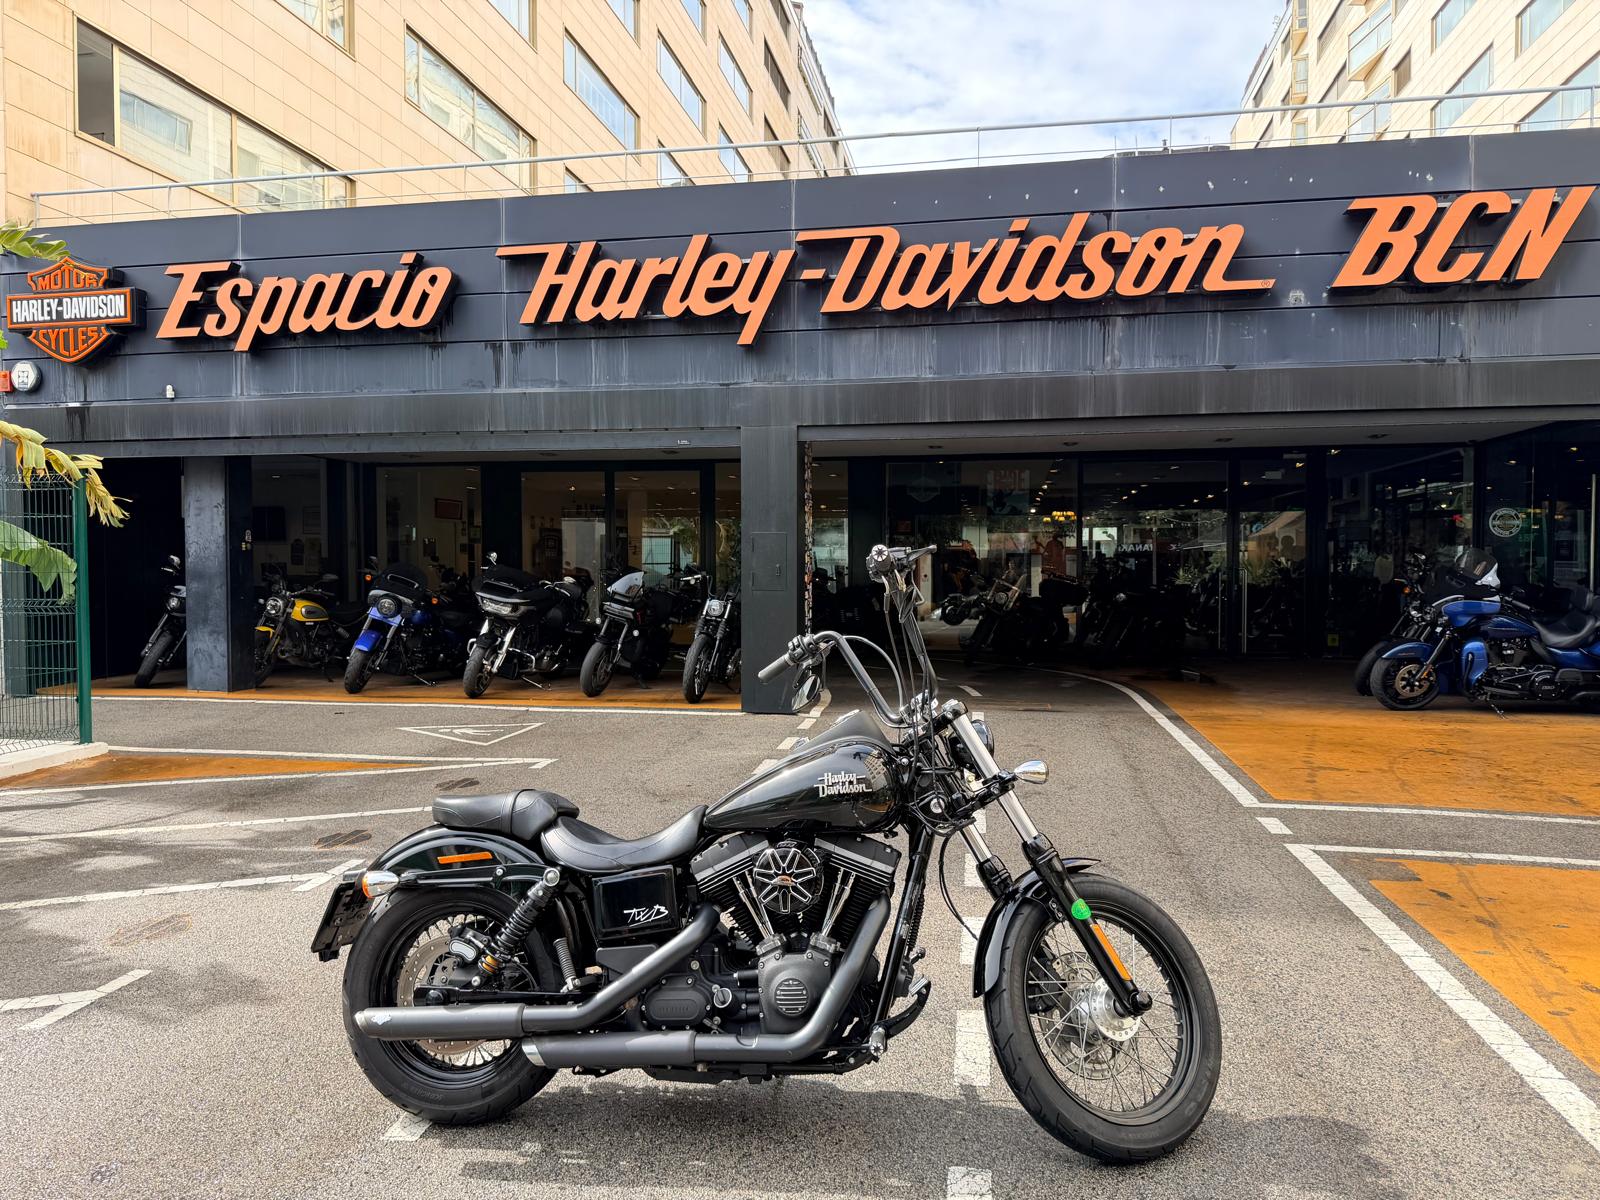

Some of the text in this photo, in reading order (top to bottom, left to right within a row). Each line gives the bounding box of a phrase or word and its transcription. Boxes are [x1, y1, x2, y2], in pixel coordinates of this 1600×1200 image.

[37, 265, 99, 291] MOTOR
[156, 252, 454, 352] Espacio
[1331, 185, 1597, 288] BCN
[12, 294, 126, 323] HARLEY-DAVIDSON
[38, 326, 99, 357] CYCLES
[813, 782, 872, 798] Davidson
[817, 771, 866, 786] Harley
